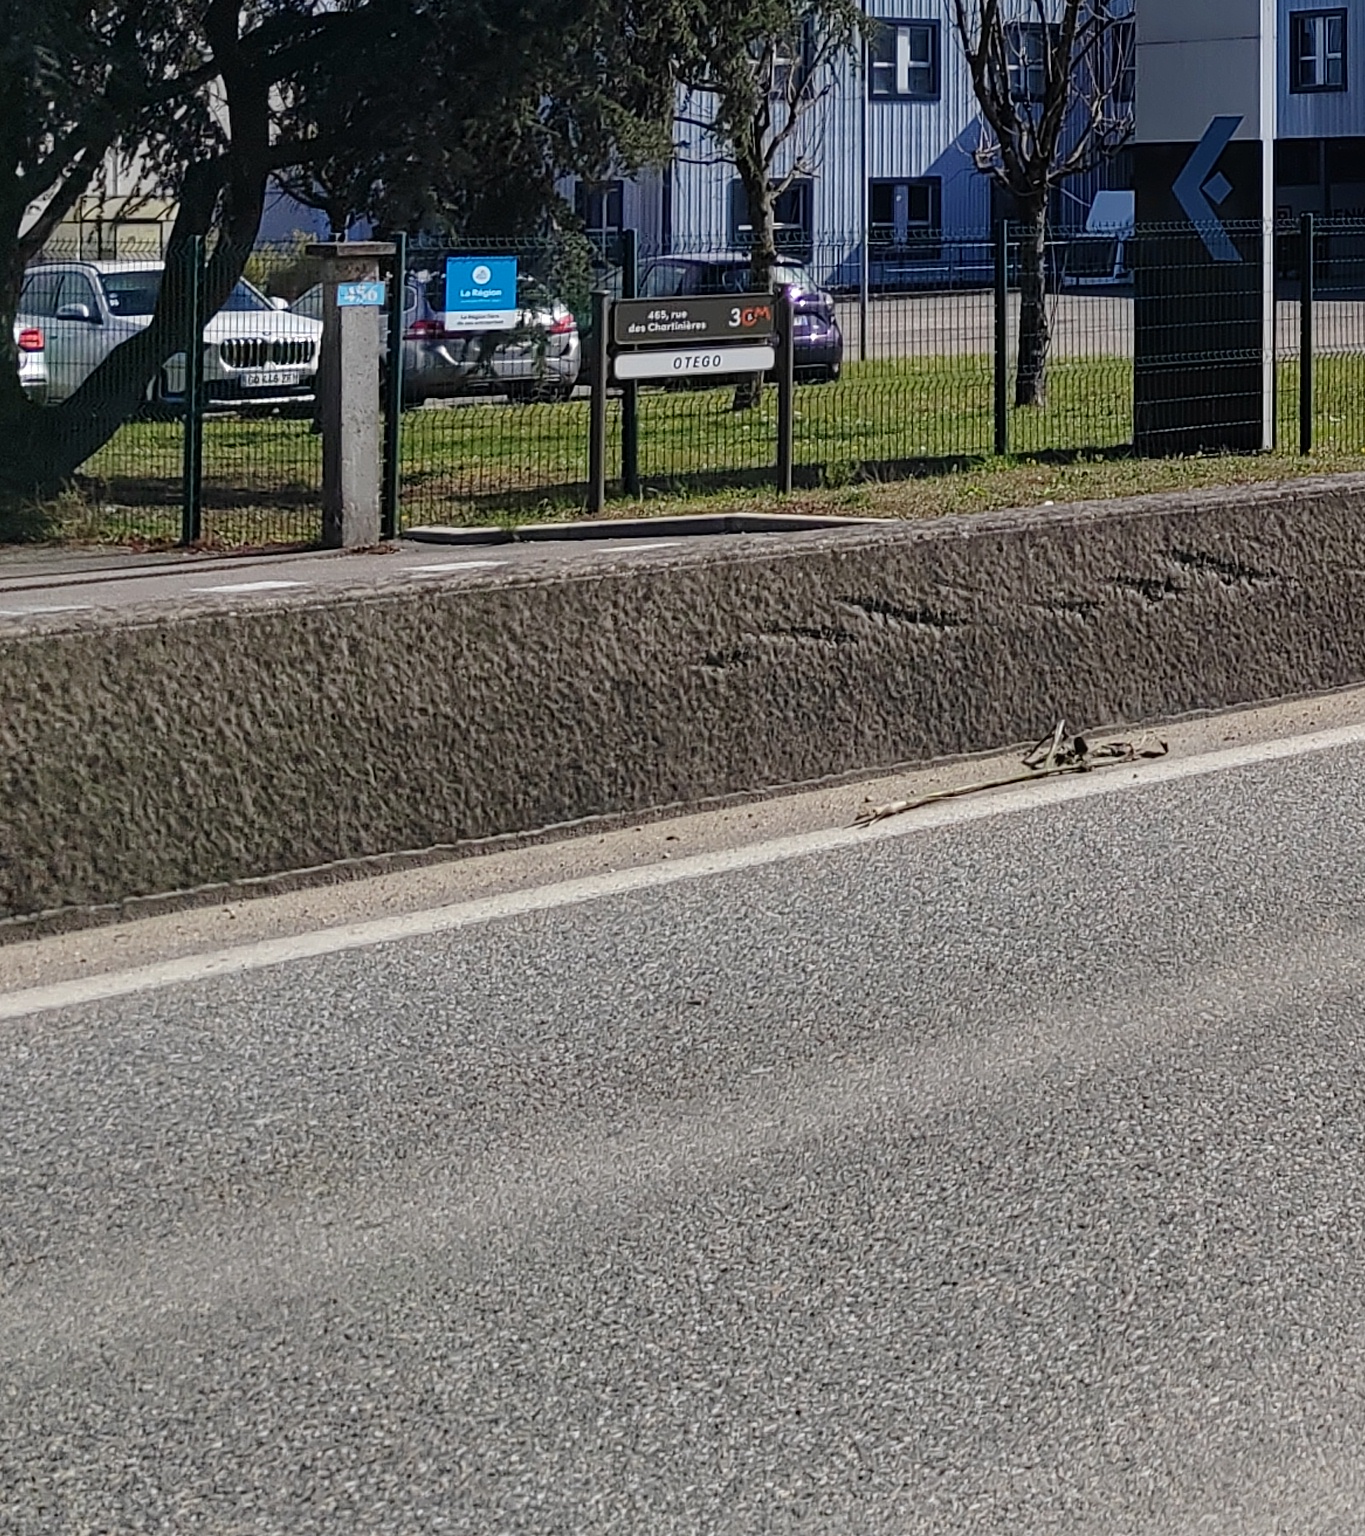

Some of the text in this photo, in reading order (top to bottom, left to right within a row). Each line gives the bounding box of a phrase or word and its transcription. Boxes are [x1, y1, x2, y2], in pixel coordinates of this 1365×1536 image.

[671, 311, 688, 320] rue
[628, 321, 707, 333] des Chartinières
[673, 355, 722, 370] OTEGO
